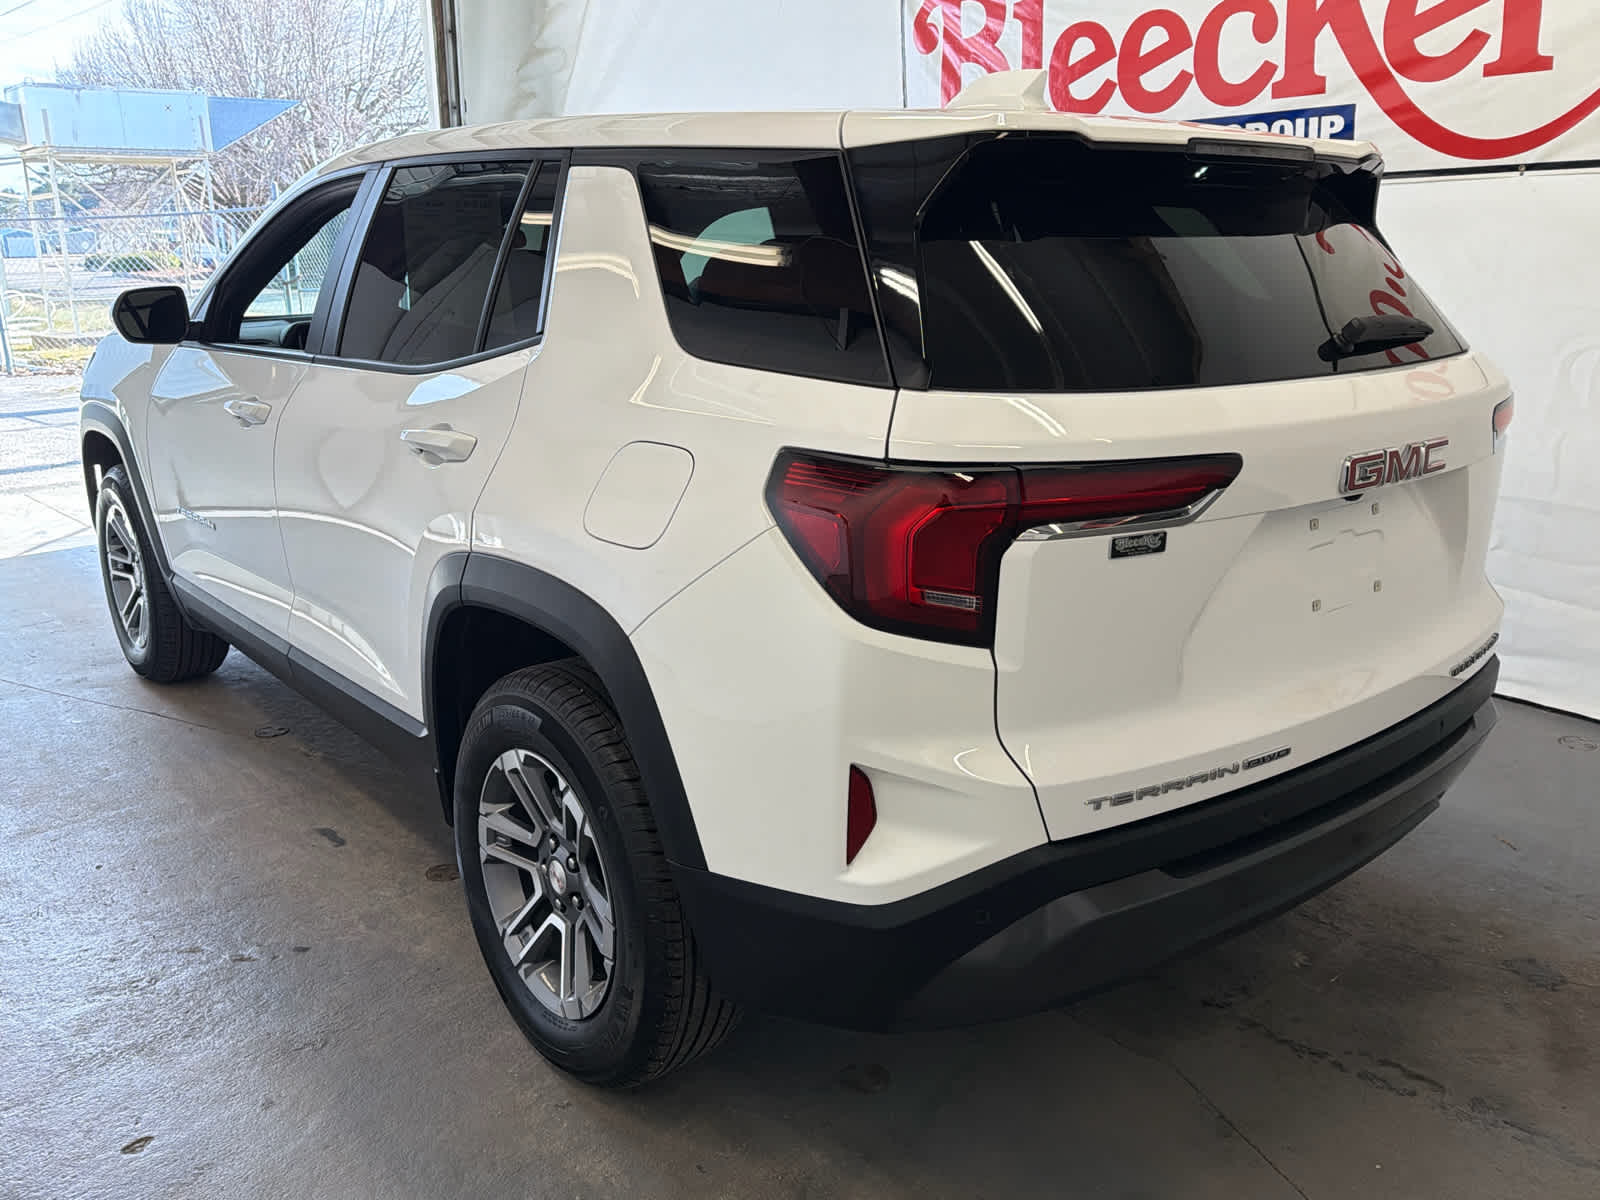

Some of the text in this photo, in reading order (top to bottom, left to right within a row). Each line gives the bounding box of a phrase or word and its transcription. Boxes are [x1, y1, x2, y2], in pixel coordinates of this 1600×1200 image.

[1222, 114, 1345, 140] OUP
[1340, 436, 1449, 494] GMC
[1085, 761, 1241, 811] TERRAIN
